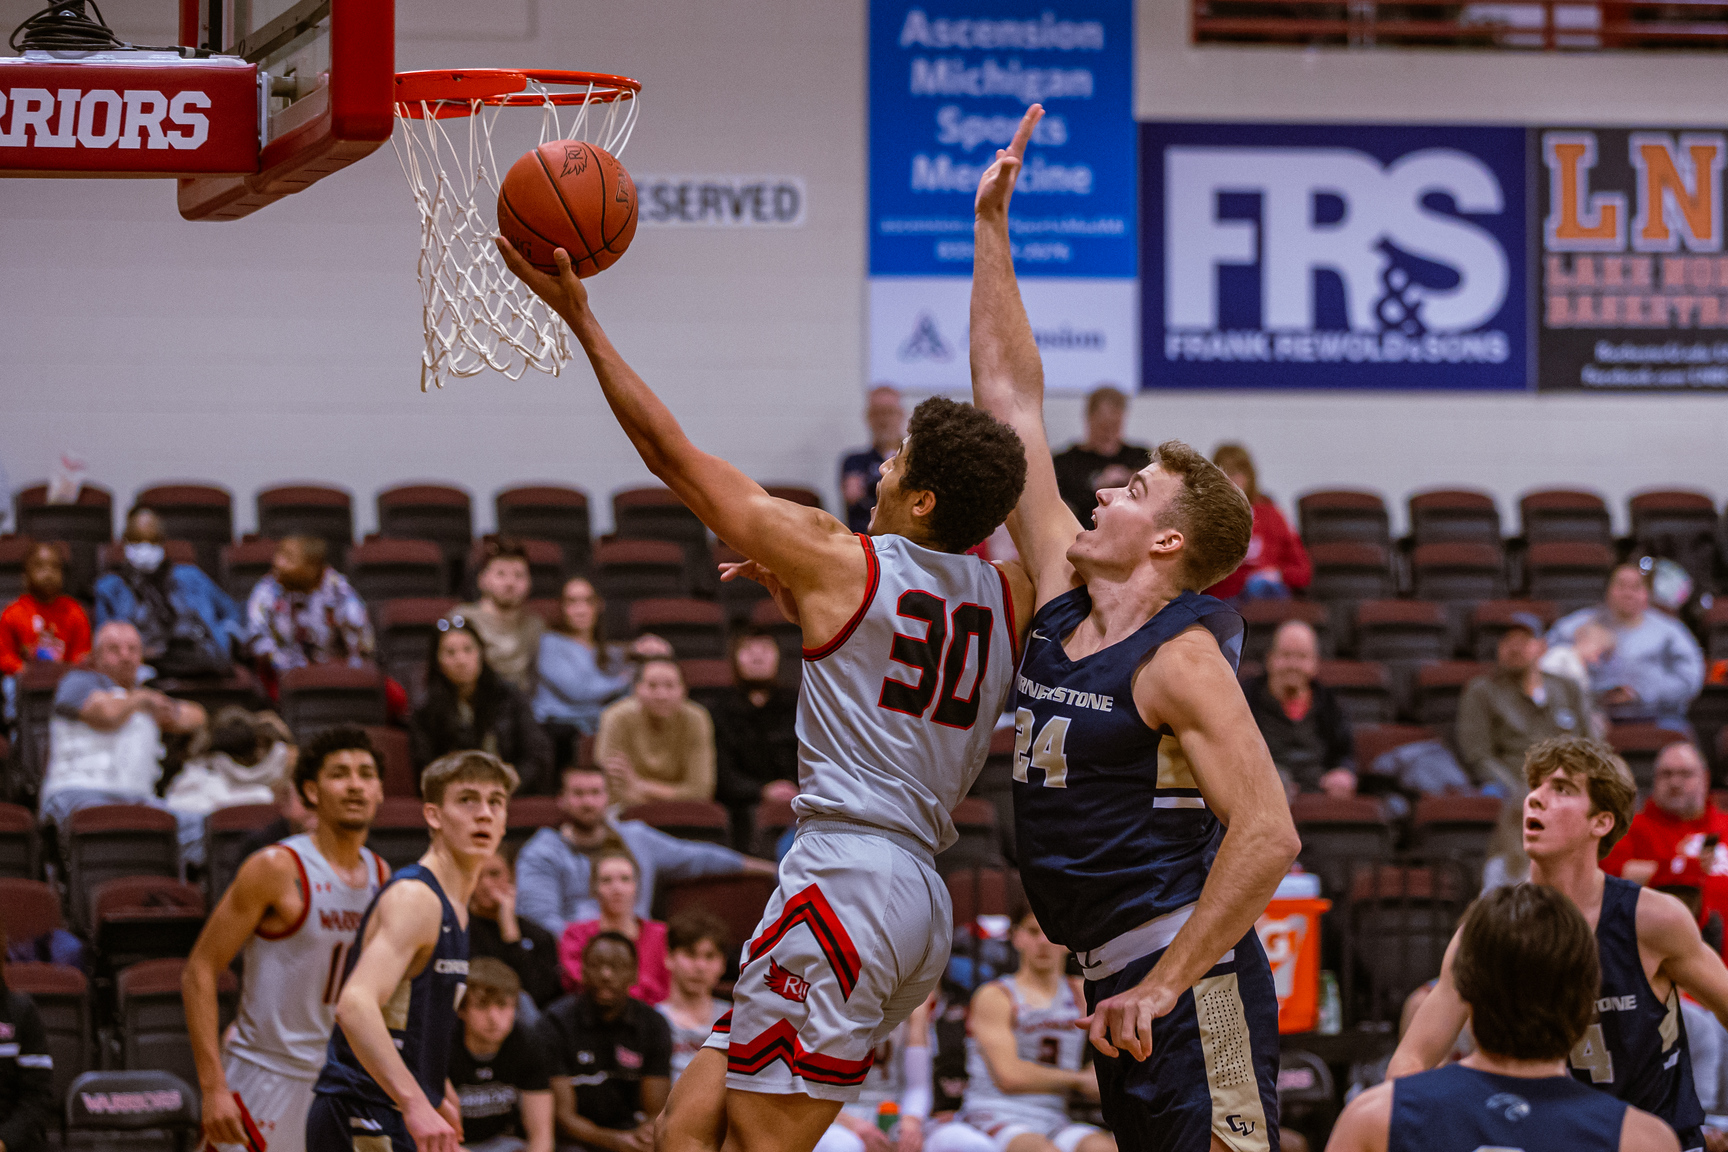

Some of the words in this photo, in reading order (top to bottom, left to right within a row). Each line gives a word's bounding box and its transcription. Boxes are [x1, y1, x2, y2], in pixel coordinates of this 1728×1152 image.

[900, 9, 1104, 50] Ascension
[910, 57, 1094, 105] Michigan
[0, 88, 212, 150] RIORS
[911, 153, 1093, 195] Mecine
[1542, 131, 1727, 252] LN
[1163, 146, 1511, 334] FRS
[1546, 293, 1728, 329] BASKETB
[1164, 330, 1271, 362] FRANK
[878, 589, 995, 731] 30
[1012, 706, 1073, 788] 24
